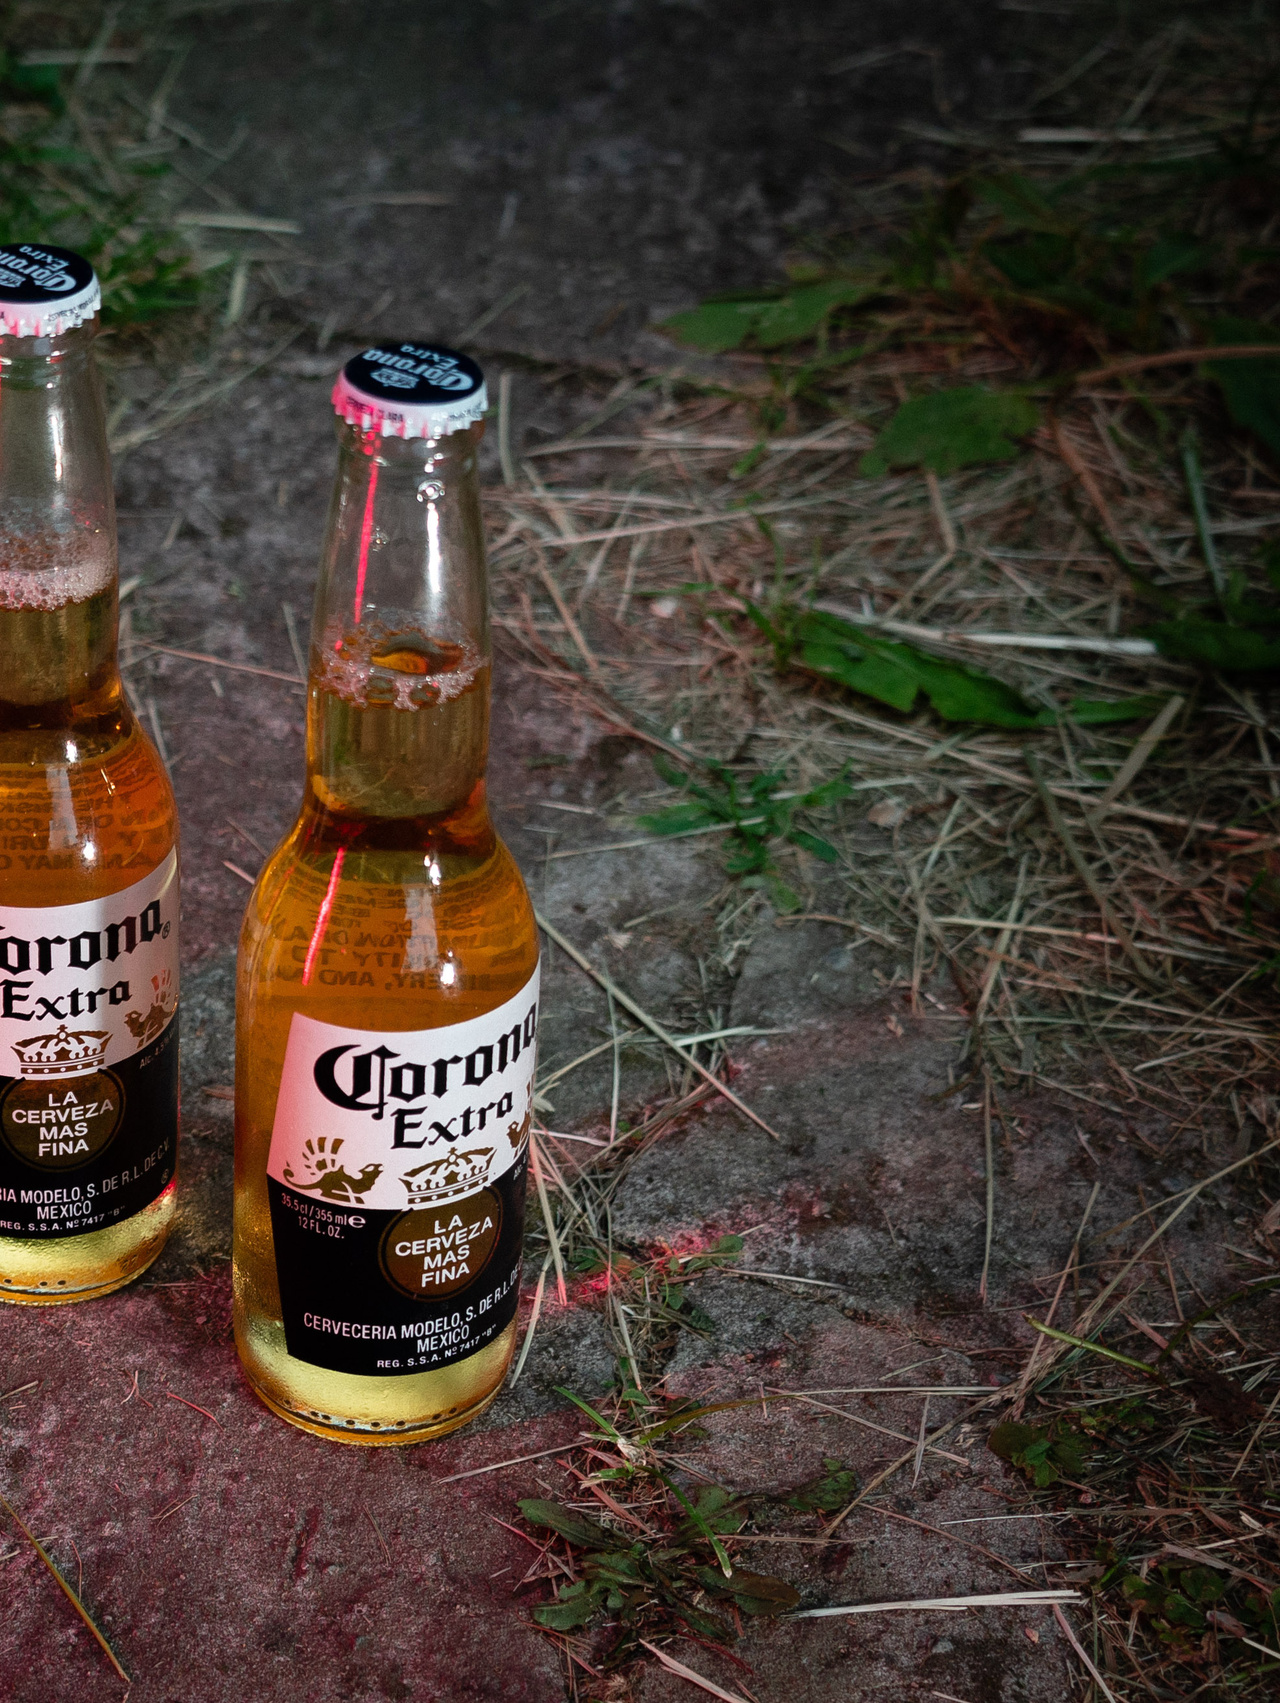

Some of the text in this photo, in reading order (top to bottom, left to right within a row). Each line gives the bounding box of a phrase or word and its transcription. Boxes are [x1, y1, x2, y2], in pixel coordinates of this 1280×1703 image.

[19, 245, 70, 272] Extra
[362, 349, 474, 391] Corona
[400, 344, 460, 370] Extra
[313, 1001, 537, 1121] Corona
[12, 1099, 114, 1124] CERVEZA
[48, 1091, 78, 1107] LA
[40, 1122, 88, 1140] MAS
[390, 1091, 513, 1150] Extra
[38, 1139, 90, 1157] FINA
[20, 1186, 84, 1204] MODELO,
[86, 1183, 100, 1198] S.
[102, 1175, 119, 1194] DE
[144, 1151, 157, 1172] DE
[0, 1220, 25, 1231] REG.
[82, 1213, 105, 1226] 7417
[37, 1200, 92, 1220] MEXICO
[395, 1216, 493, 1256] CERVEZA
[434, 1215, 463, 1234] LA
[423, 1244, 470, 1270] MAS
[421, 1262, 470, 1288] FINA
[303, 1312, 397, 1340] CERVECERIA
[401, 1312, 464, 1339] MODELO,
[465, 1306, 477, 1321] S.
[479, 1294, 493, 1315] DE
[377, 1359, 404, 1368] REG.
[460, 1335, 480, 1353] 7417
[417, 1324, 470, 1353] MEXICO
